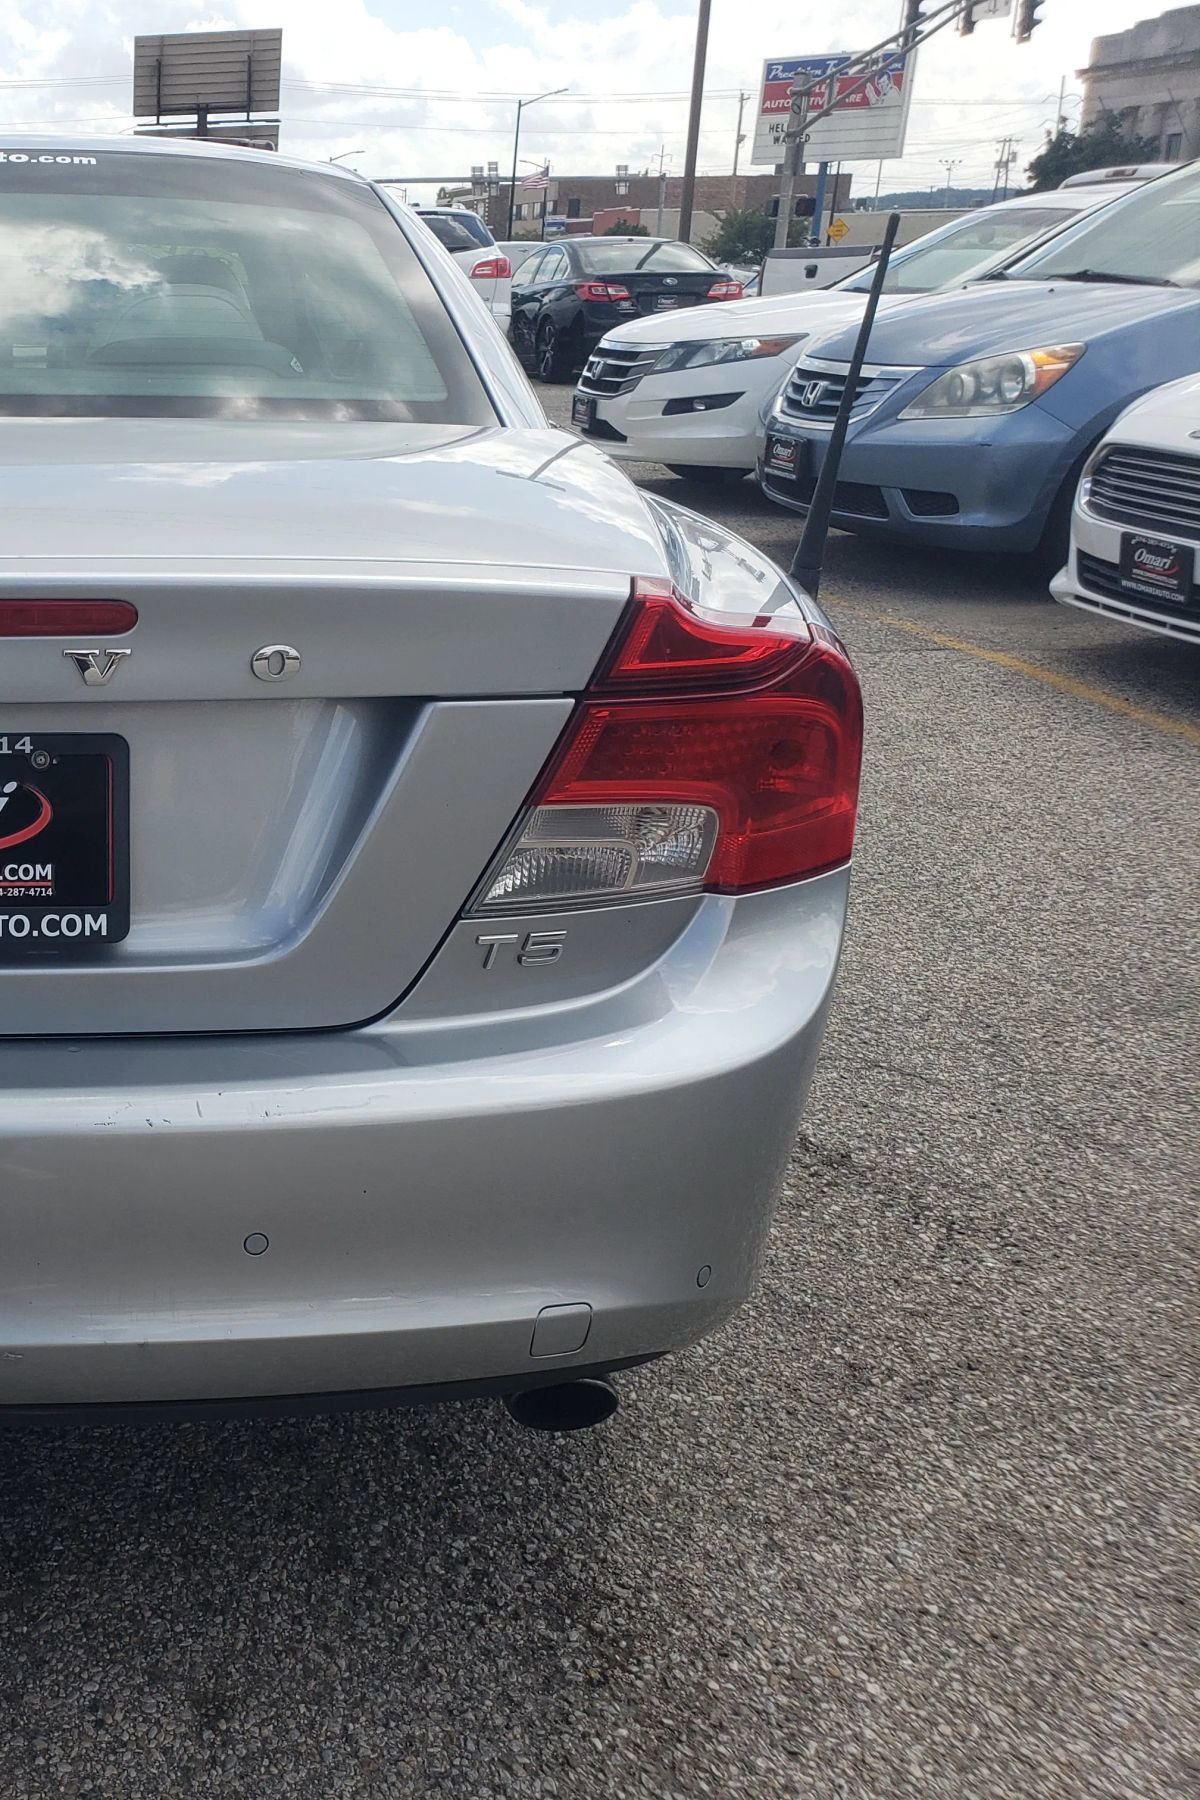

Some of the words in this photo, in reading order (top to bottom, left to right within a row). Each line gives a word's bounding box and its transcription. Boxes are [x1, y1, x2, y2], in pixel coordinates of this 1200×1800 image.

[763, 97, 832, 108] AUTOTIV
[769, 123, 786, 134] HEL
[773, 133, 811, 145] WAED
[1134, 548, 1174, 569] Omari
[475, 930, 568, 970] T5
